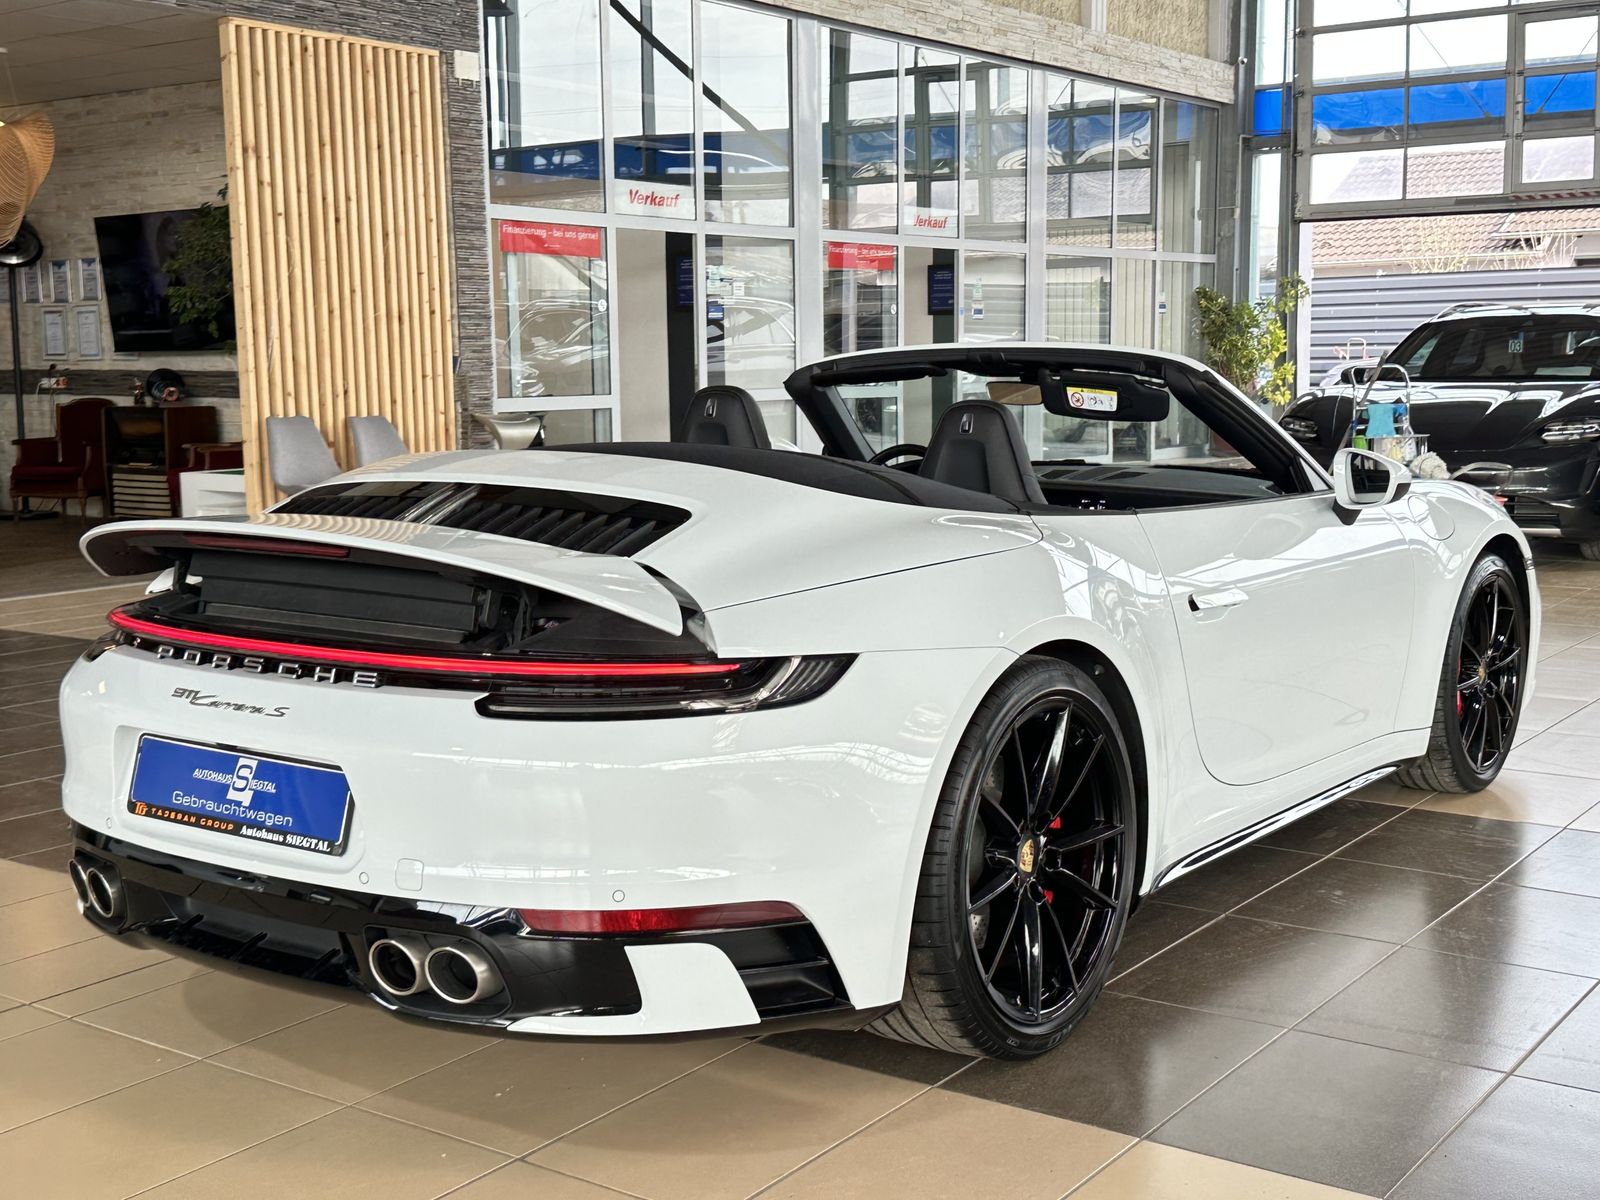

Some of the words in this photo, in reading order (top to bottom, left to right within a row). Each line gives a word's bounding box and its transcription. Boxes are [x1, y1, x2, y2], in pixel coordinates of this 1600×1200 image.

[629, 189, 680, 208] Verkauf
[502, 224, 547, 238] Finanzierung
[553, 228, 563, 237] bei
[565, 231, 577, 239] uns
[577, 232, 599, 240] gerne!
[156, 644, 379, 689] PORSCHE
[171, 687, 200, 700] 911
[189, 694, 265, 715] Carrera
[264, 706, 291, 718] S
[192, 768, 233, 785] AUTOHAUS
[172, 790, 293, 827] Gebrauchtwagen
[200, 818, 234, 831] GROUP
[240, 825, 285, 842] Autohaus
[285, 834, 331, 852] SIEGTAL
